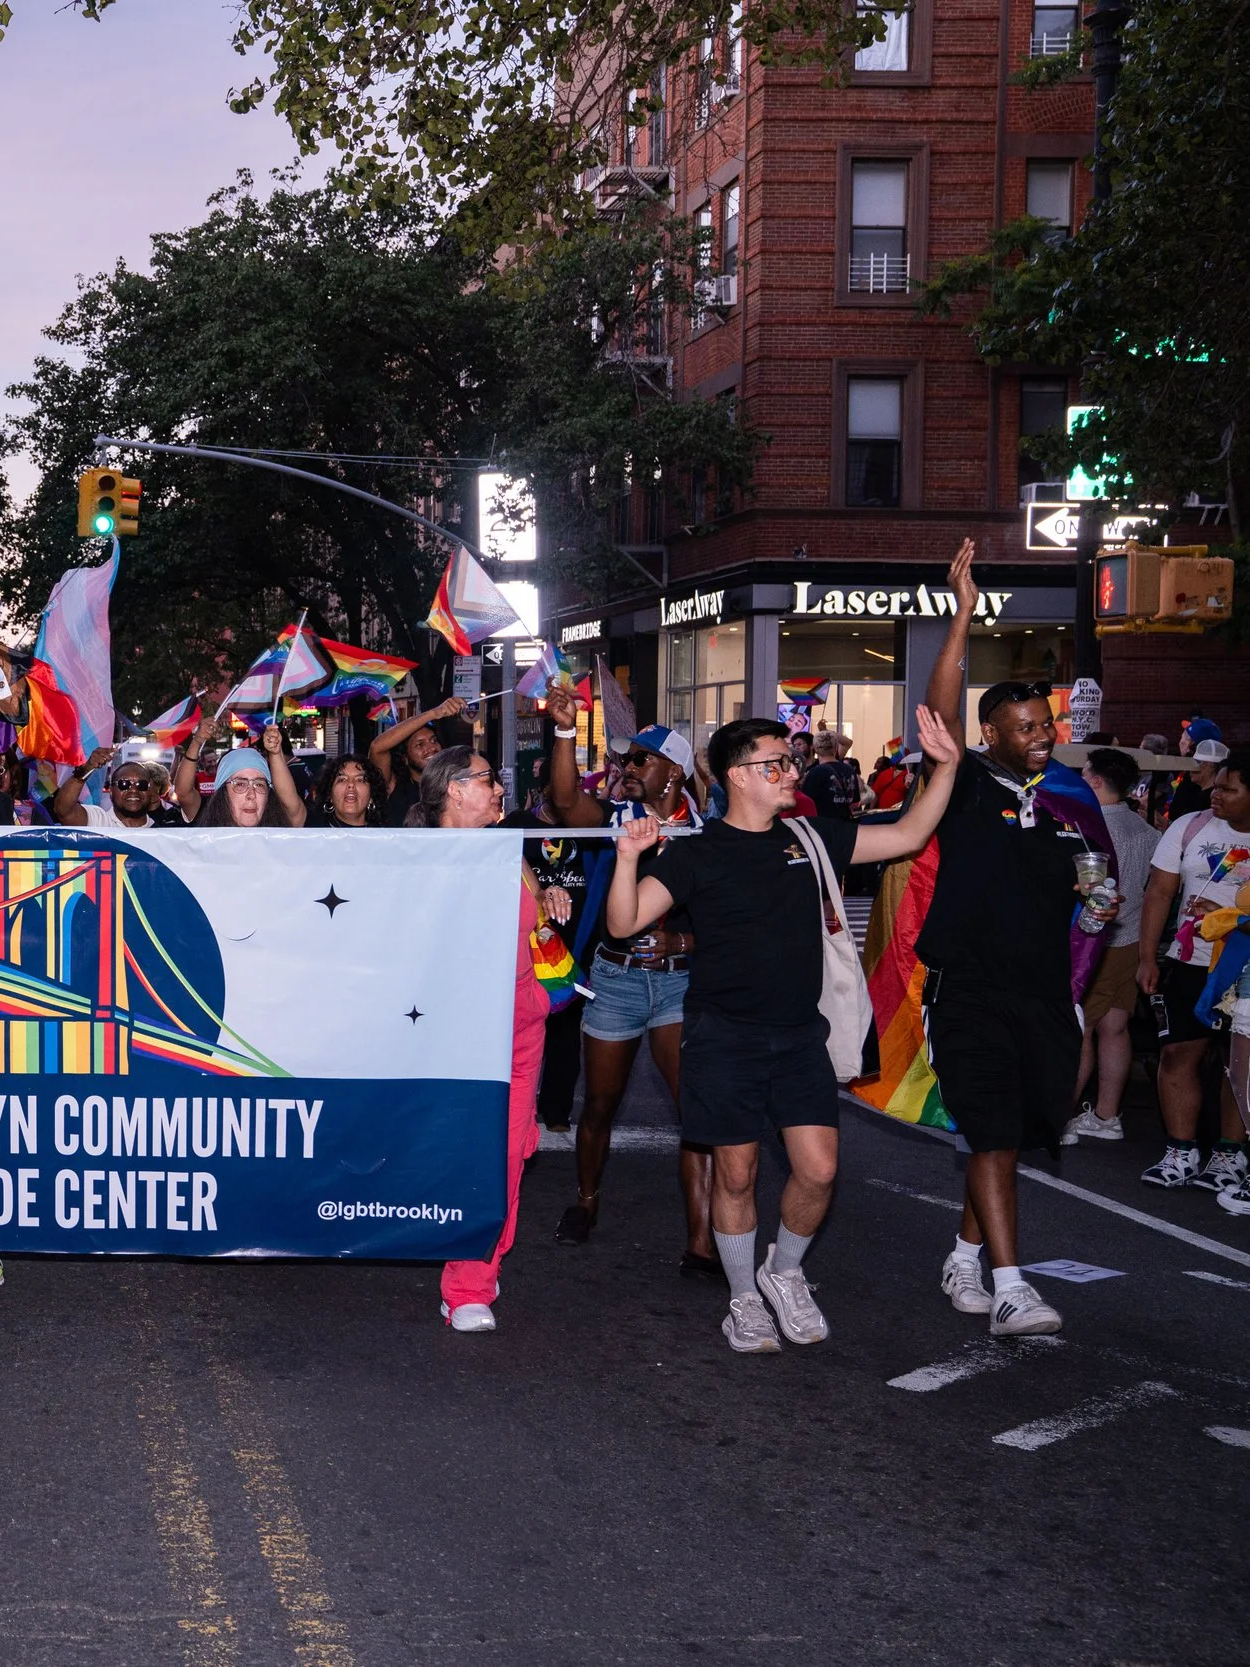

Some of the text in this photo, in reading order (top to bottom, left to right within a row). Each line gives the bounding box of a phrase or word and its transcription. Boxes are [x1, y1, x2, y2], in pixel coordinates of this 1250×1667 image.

[1054, 519, 1079, 535] ON
[660, 589, 725, 625] LaserAway
[54, 1094, 325, 1160] COMMUNITY
[54, 1168, 219, 1231] CENTER
[317, 1200, 464, 1225] @lgbtbrooklyn
